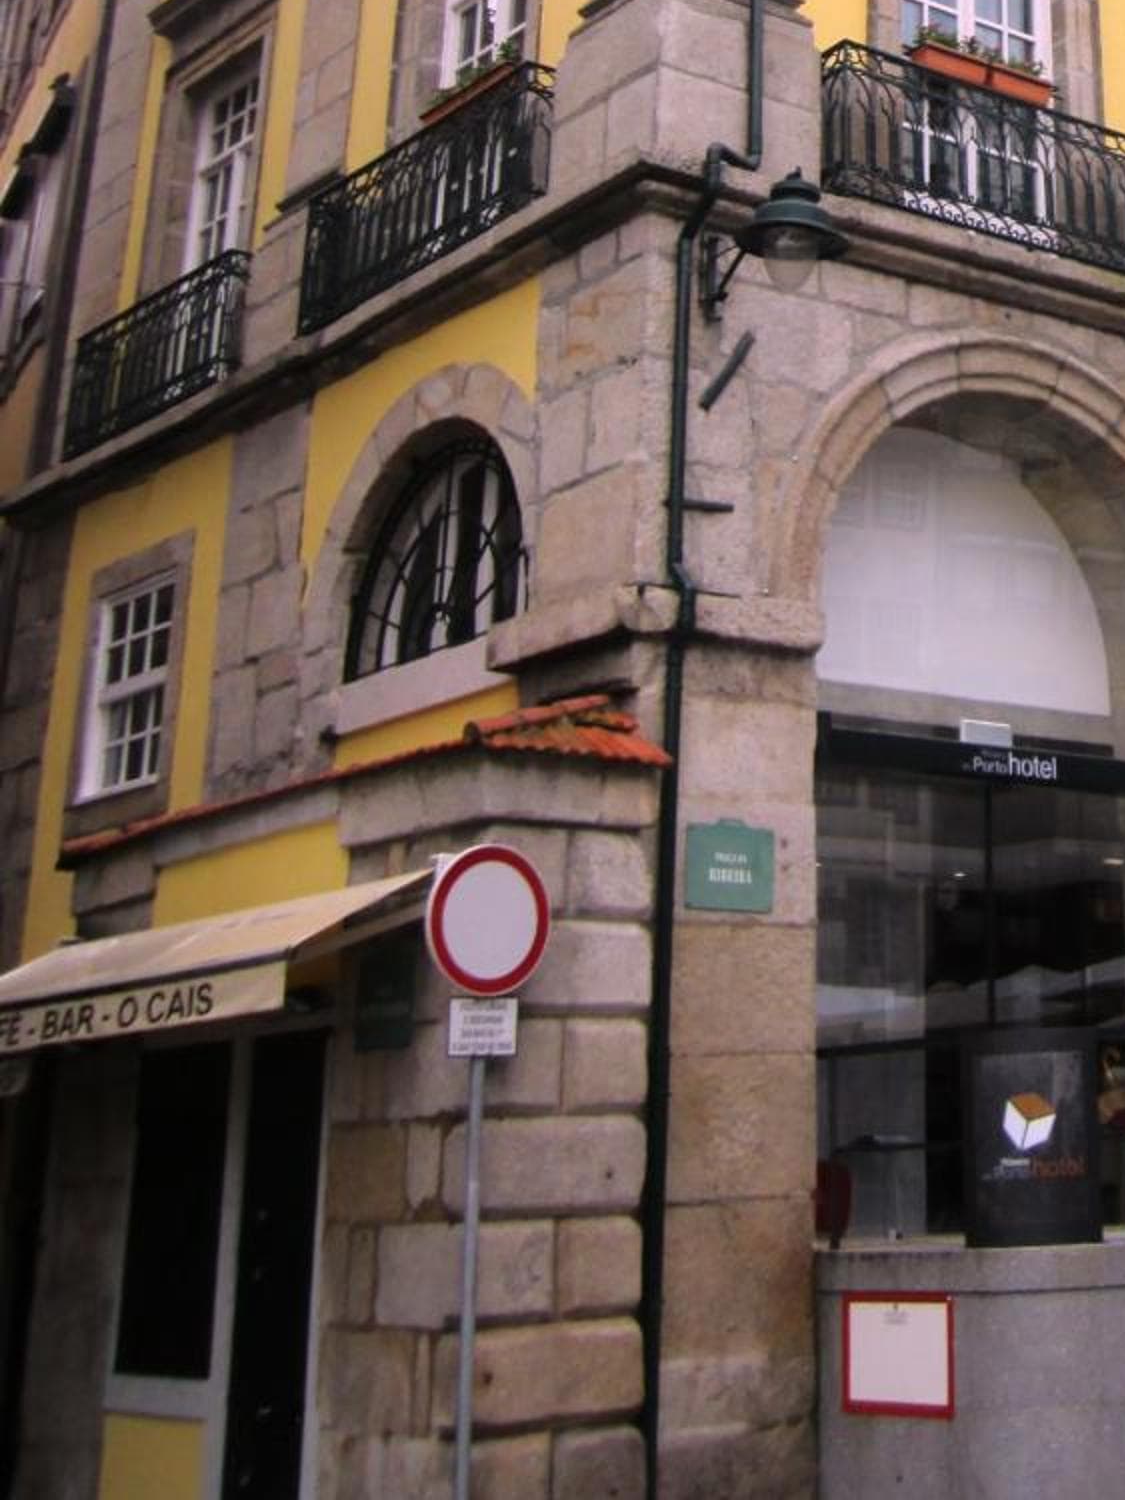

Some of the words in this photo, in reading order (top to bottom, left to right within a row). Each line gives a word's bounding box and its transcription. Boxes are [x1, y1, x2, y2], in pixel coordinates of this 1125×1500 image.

[1008, 751, 1058, 780] hotel
[40, 1003, 95, 1040] BAR
[117, 996, 139, 1029] O
[146, 982, 214, 1023] CAIS
